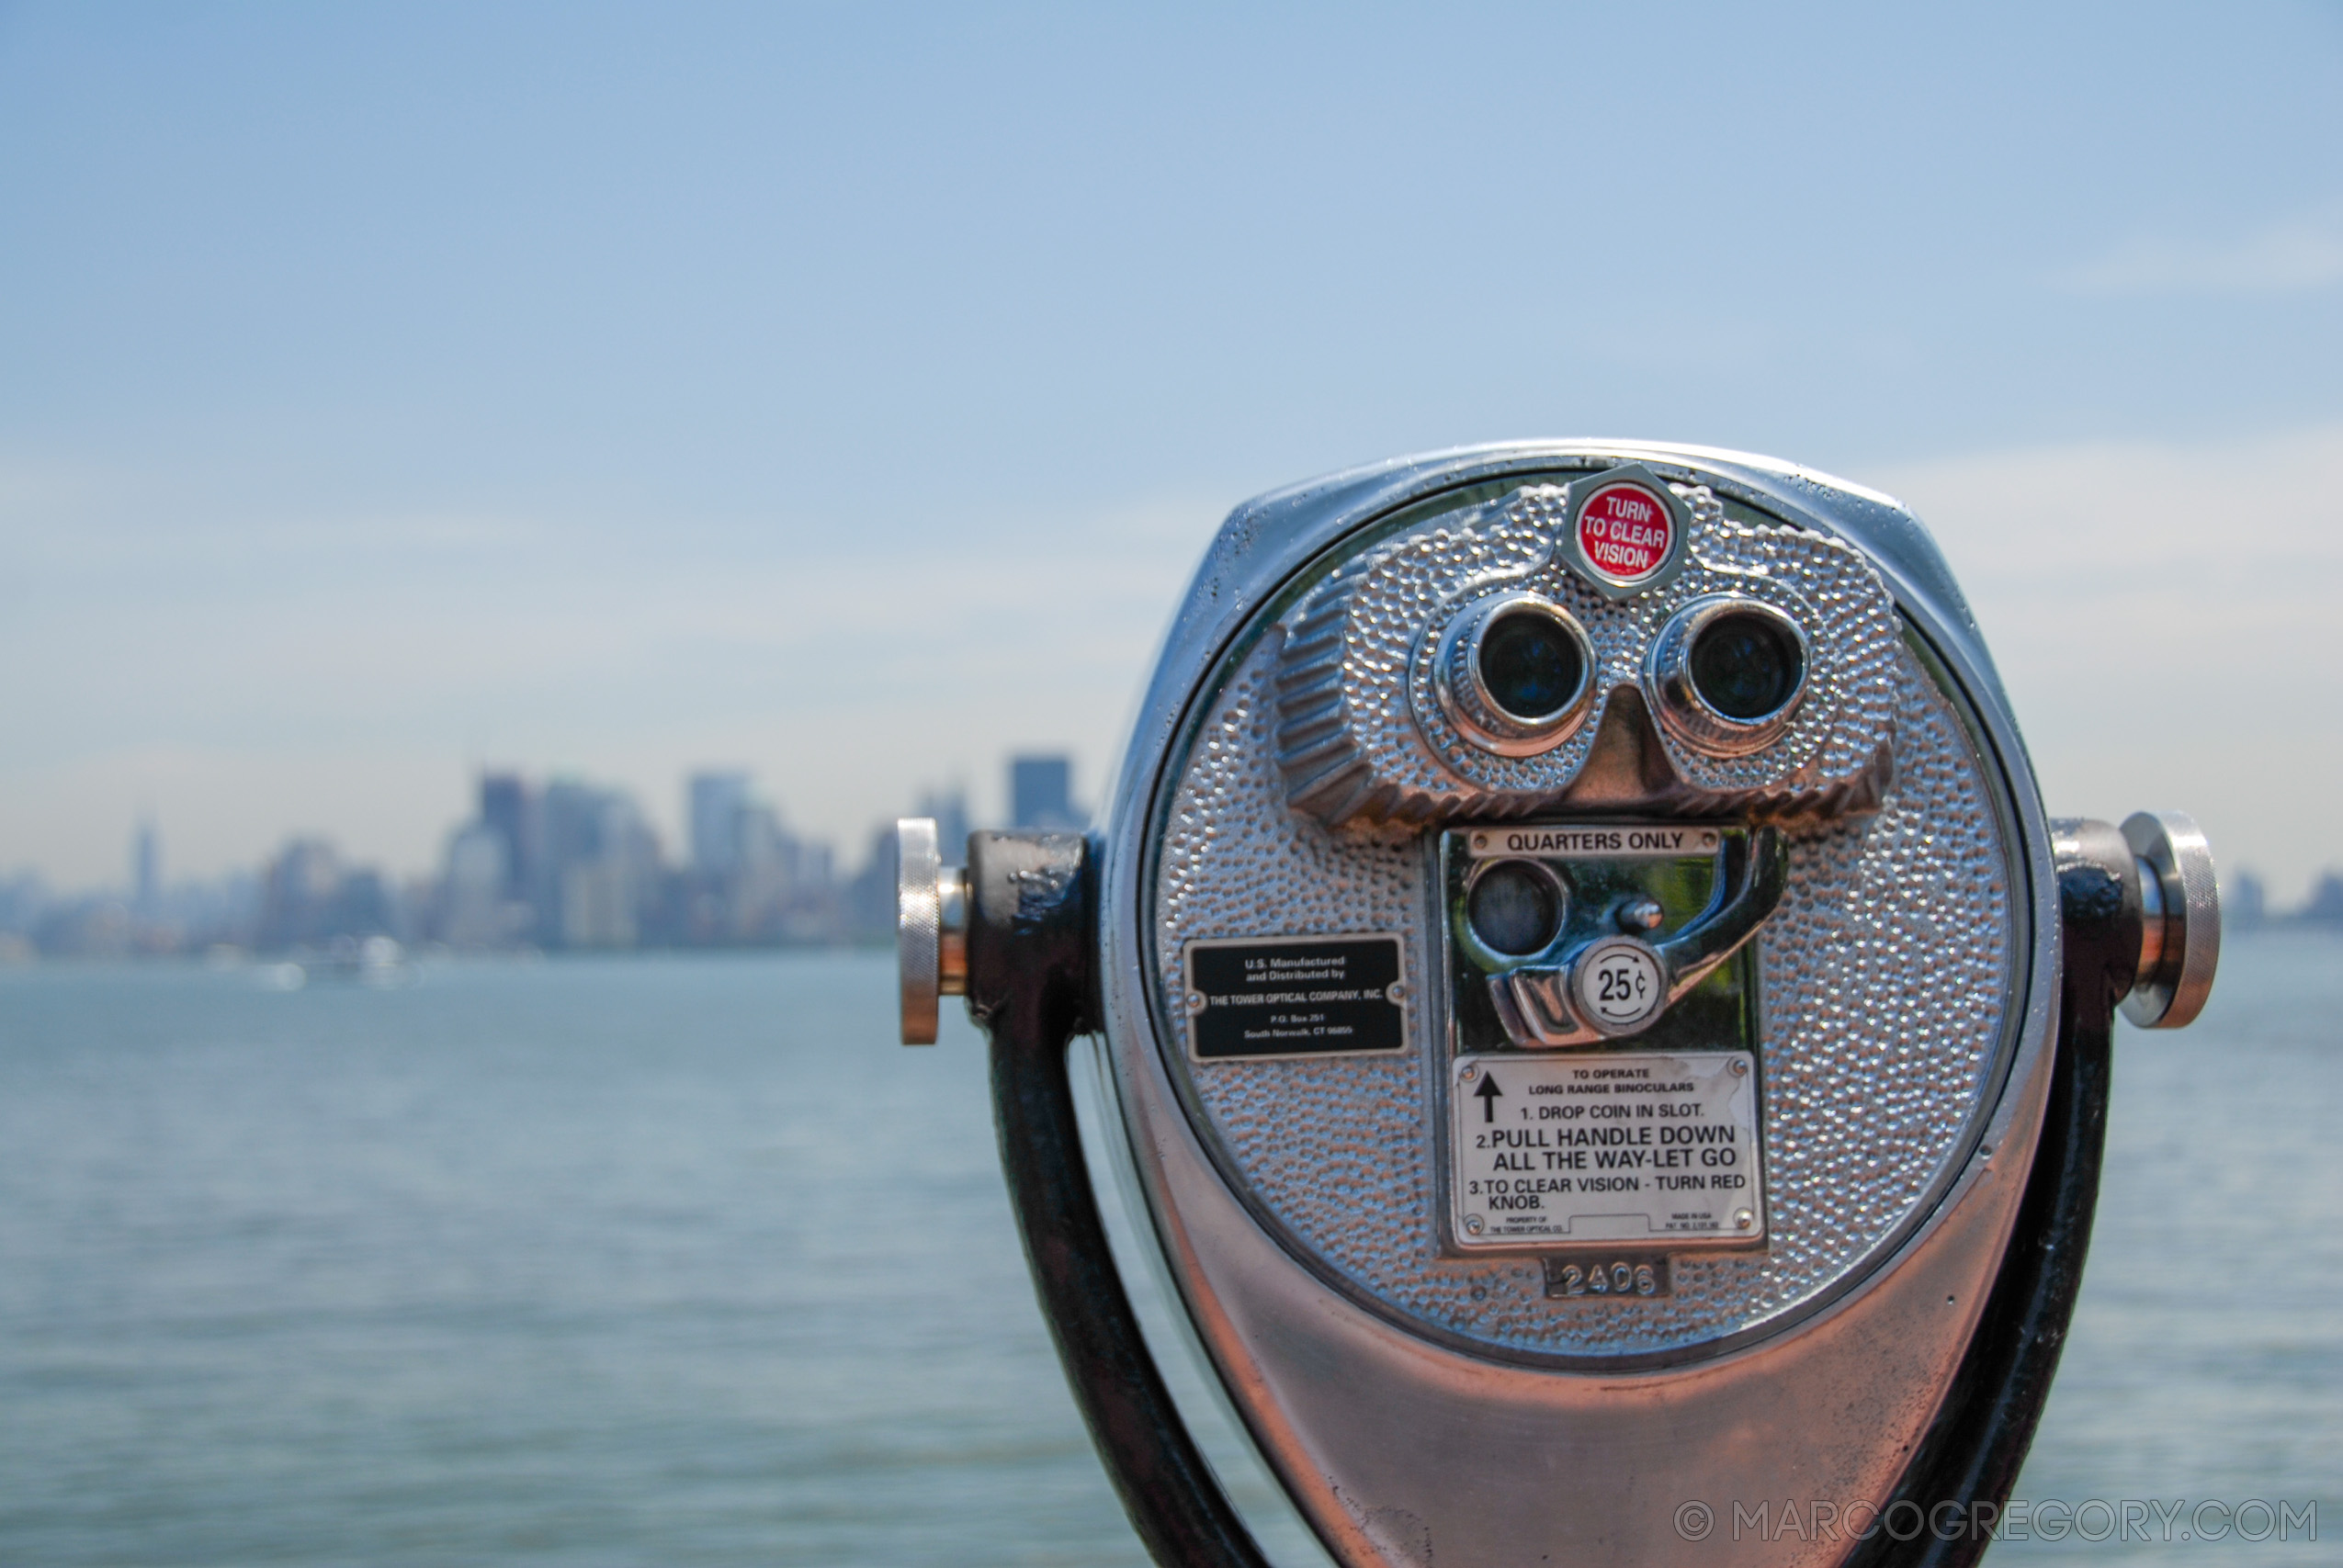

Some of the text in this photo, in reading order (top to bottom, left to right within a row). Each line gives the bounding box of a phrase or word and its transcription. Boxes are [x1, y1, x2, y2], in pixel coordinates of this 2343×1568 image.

[1606, 496, 1650, 523] TURN
[1585, 515, 1665, 549] TO CLEAR
[1594, 540, 1648, 569] VISION
[1507, 832, 1683, 852] QUARTERS ONLY
[1245, 956, 1345, 969] U.S. Manufactured
[1246, 969, 1345, 982] and Distributed by
[1209, 988, 1383, 1006] THE TOWER OPTICAL COMPANY, INC.
[1290, 1014, 1307, 1022] Box
[1244, 1030, 1270, 1039] South
[1313, 1027, 1325, 1035] CT
[1573, 1068, 1649, 1079] TO OPERATE
[1529, 1082, 1694, 1095] LONG RANGE BINOCULARS
[1521, 1103, 1704, 1120] 1. DROP COIN IN SLOT.
[1557, 1127, 1652, 1146] HANDLE
[1660, 1124, 1735, 1145] DOWN
[1493, 1152, 1536, 1171] ALL
[1542, 1151, 1587, 1170] THE
[1702, 1147, 1737, 1167] GO
[1514, 1178, 1572, 1193] CLEAR
[1578, 1176, 1639, 1192] VISION
[1655, 1175, 1705, 1190] TURN
[1711, 1174, 1746, 1190] RED
[1488, 1195, 1545, 1210] KNOB.
[1563, 1261, 1655, 1295] 2406
